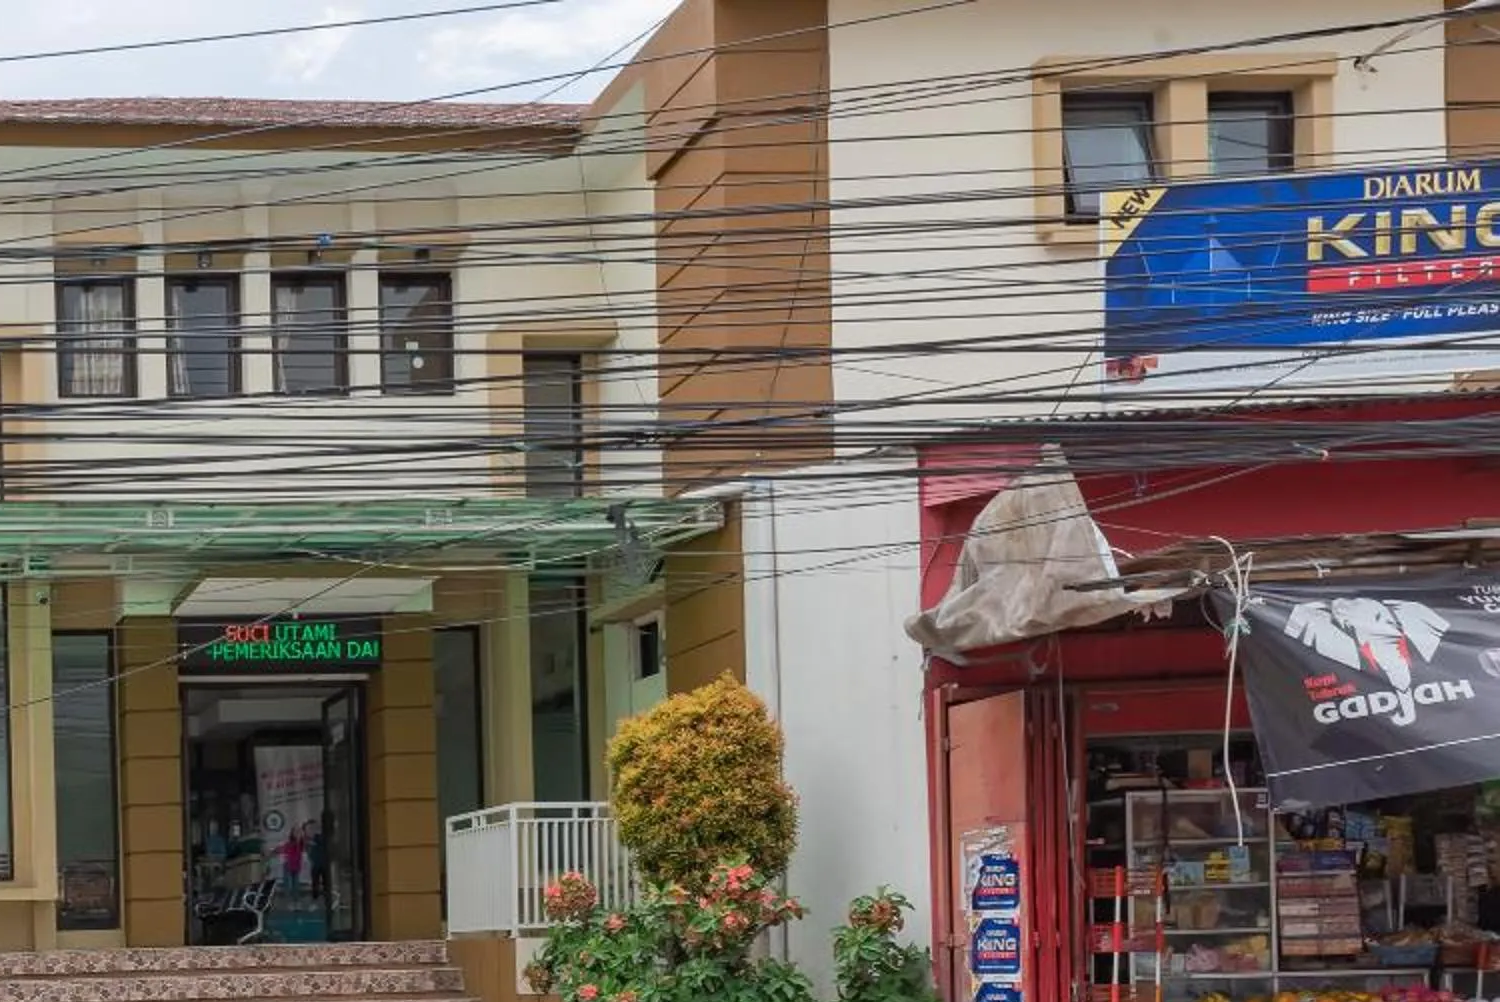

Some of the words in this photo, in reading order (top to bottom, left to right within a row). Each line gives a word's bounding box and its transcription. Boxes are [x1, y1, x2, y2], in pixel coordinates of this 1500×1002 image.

[1111, 186, 1151, 229] NEW
[225, 624, 269, 641] SUCI
[977, 938, 1017, 951] KING
